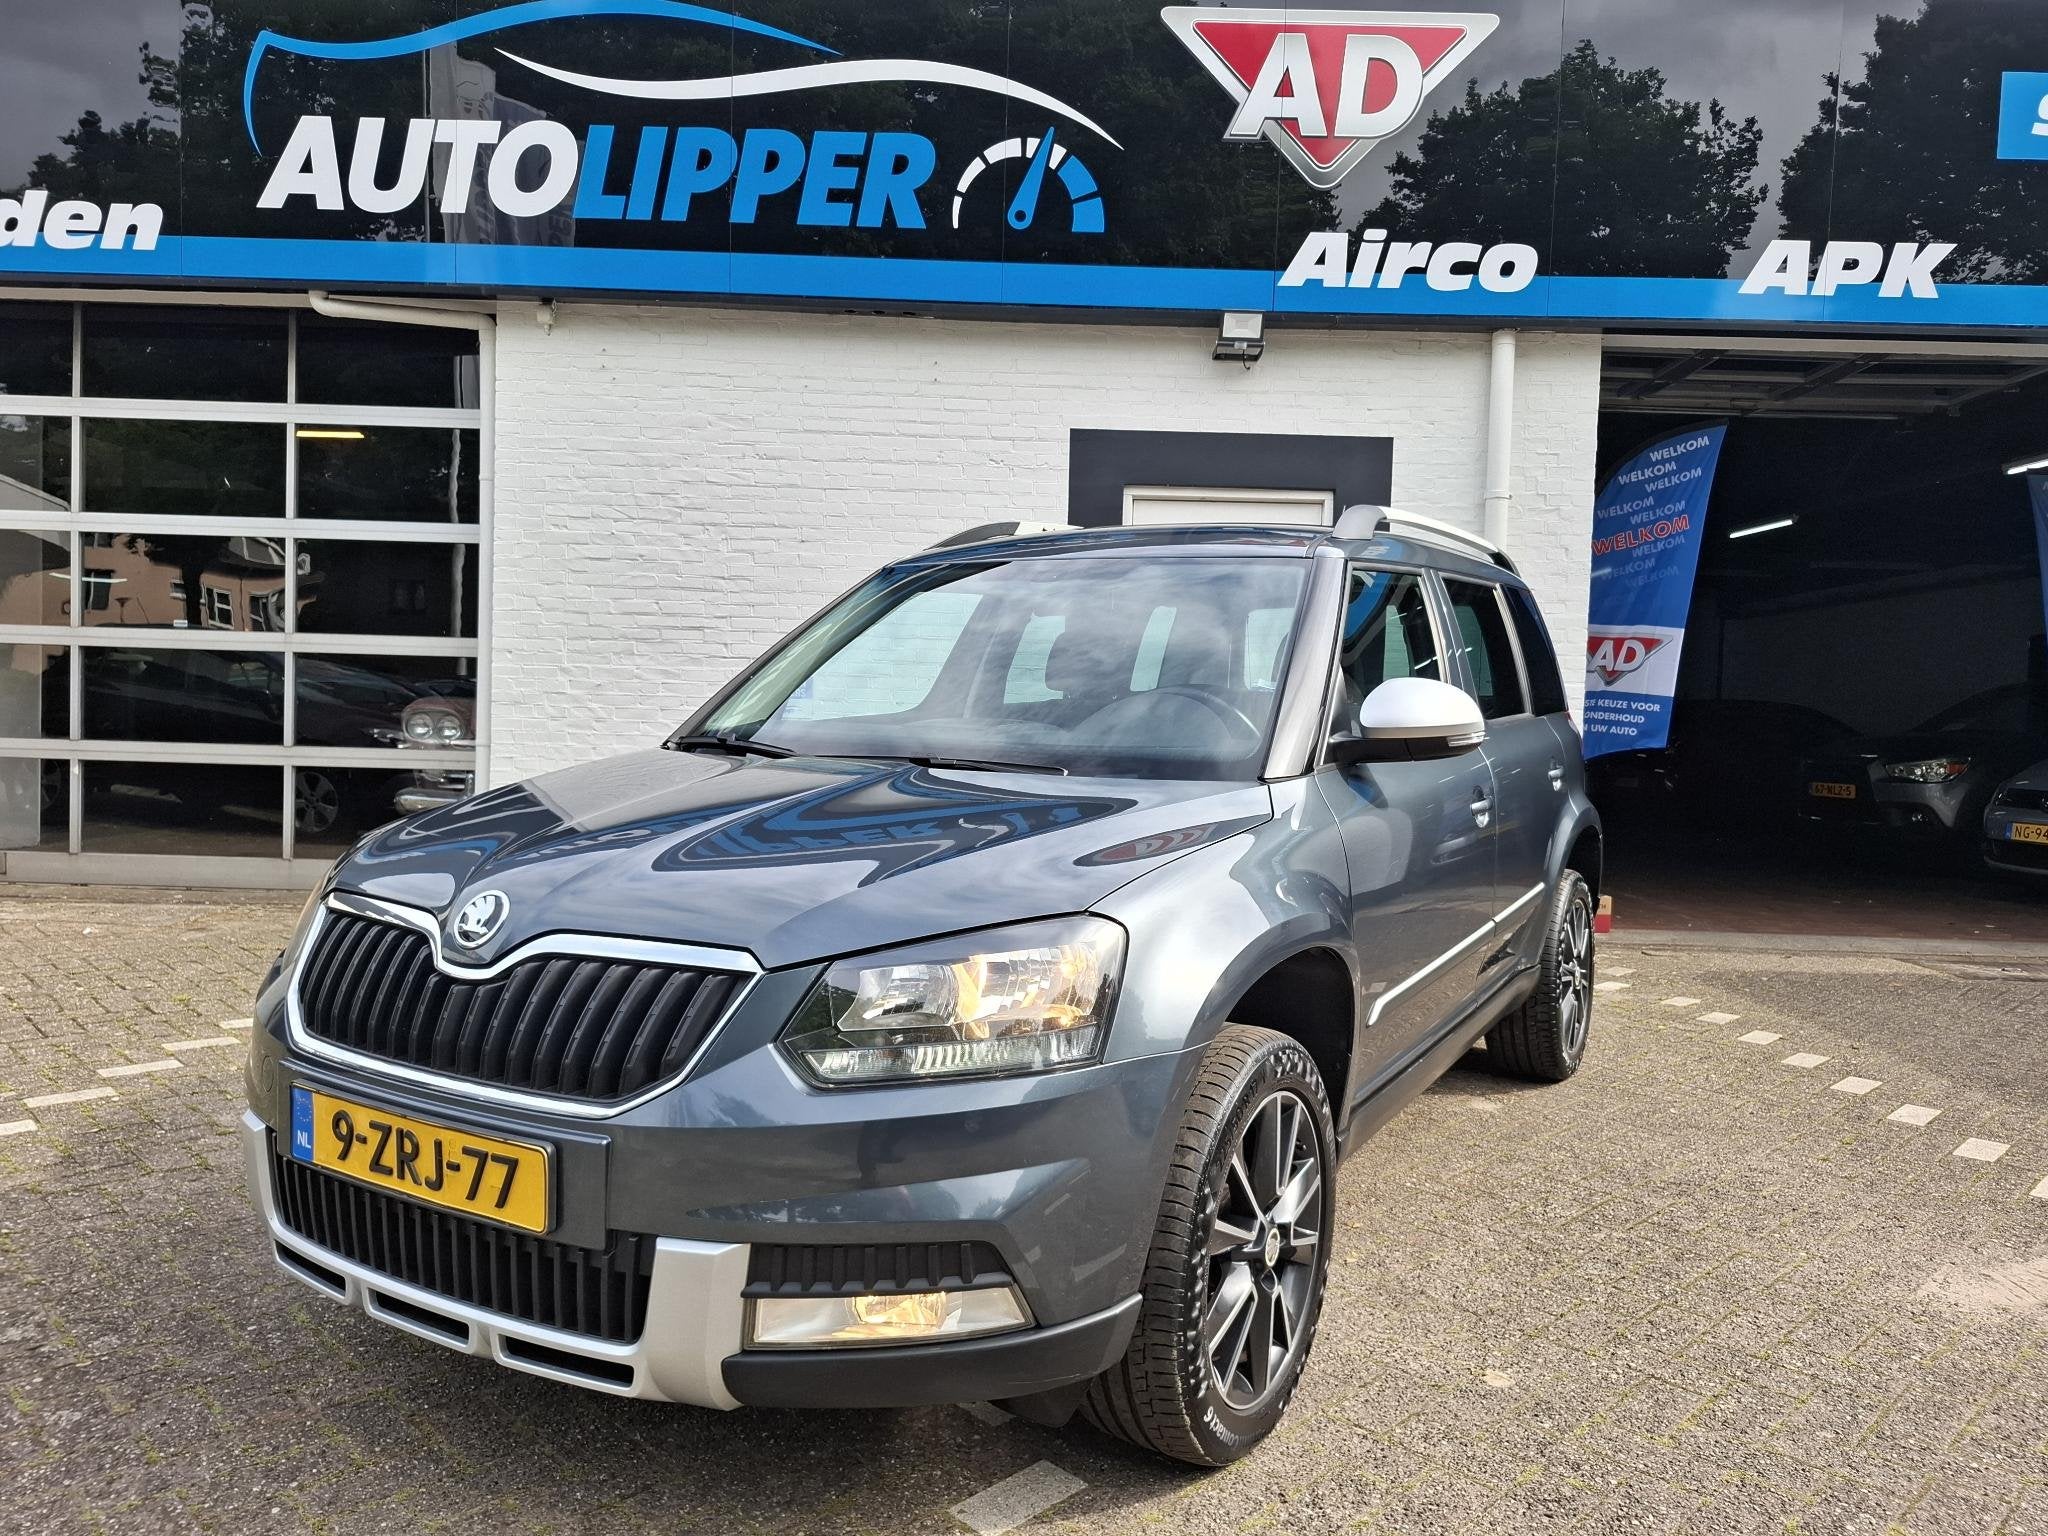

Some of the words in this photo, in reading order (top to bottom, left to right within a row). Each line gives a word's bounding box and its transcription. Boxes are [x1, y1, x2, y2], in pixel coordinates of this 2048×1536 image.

[1223, 33, 1427, 142] AD
[1278, 229, 1538, 293] Airco
[1739, 239, 1958, 299] APK
[1649, 435, 1710, 462] WELKOM
[1618, 461, 1677, 486] WELKOM
[1645, 467, 1702, 493] WELKOM
[1597, 495, 1655, 520] WELKOM
[1630, 500, 1687, 525] WELKOM
[1591, 514, 1691, 556] WELKOM
[1632, 535, 1686, 558] WELKOM
[1590, 640, 1647, 671] AD
[1584, 711, 1645, 724] ONDERHOUD
[1598, 699, 1628, 709] KEUZE
[1630, 701, 1661, 712] VOOR
[1591, 724, 1608, 733] UW
[1610, 726, 1638, 736] AUTO
[296, 1129, 313, 1150] NL
[331, 1108, 520, 1210] 9-ZRJ-77
